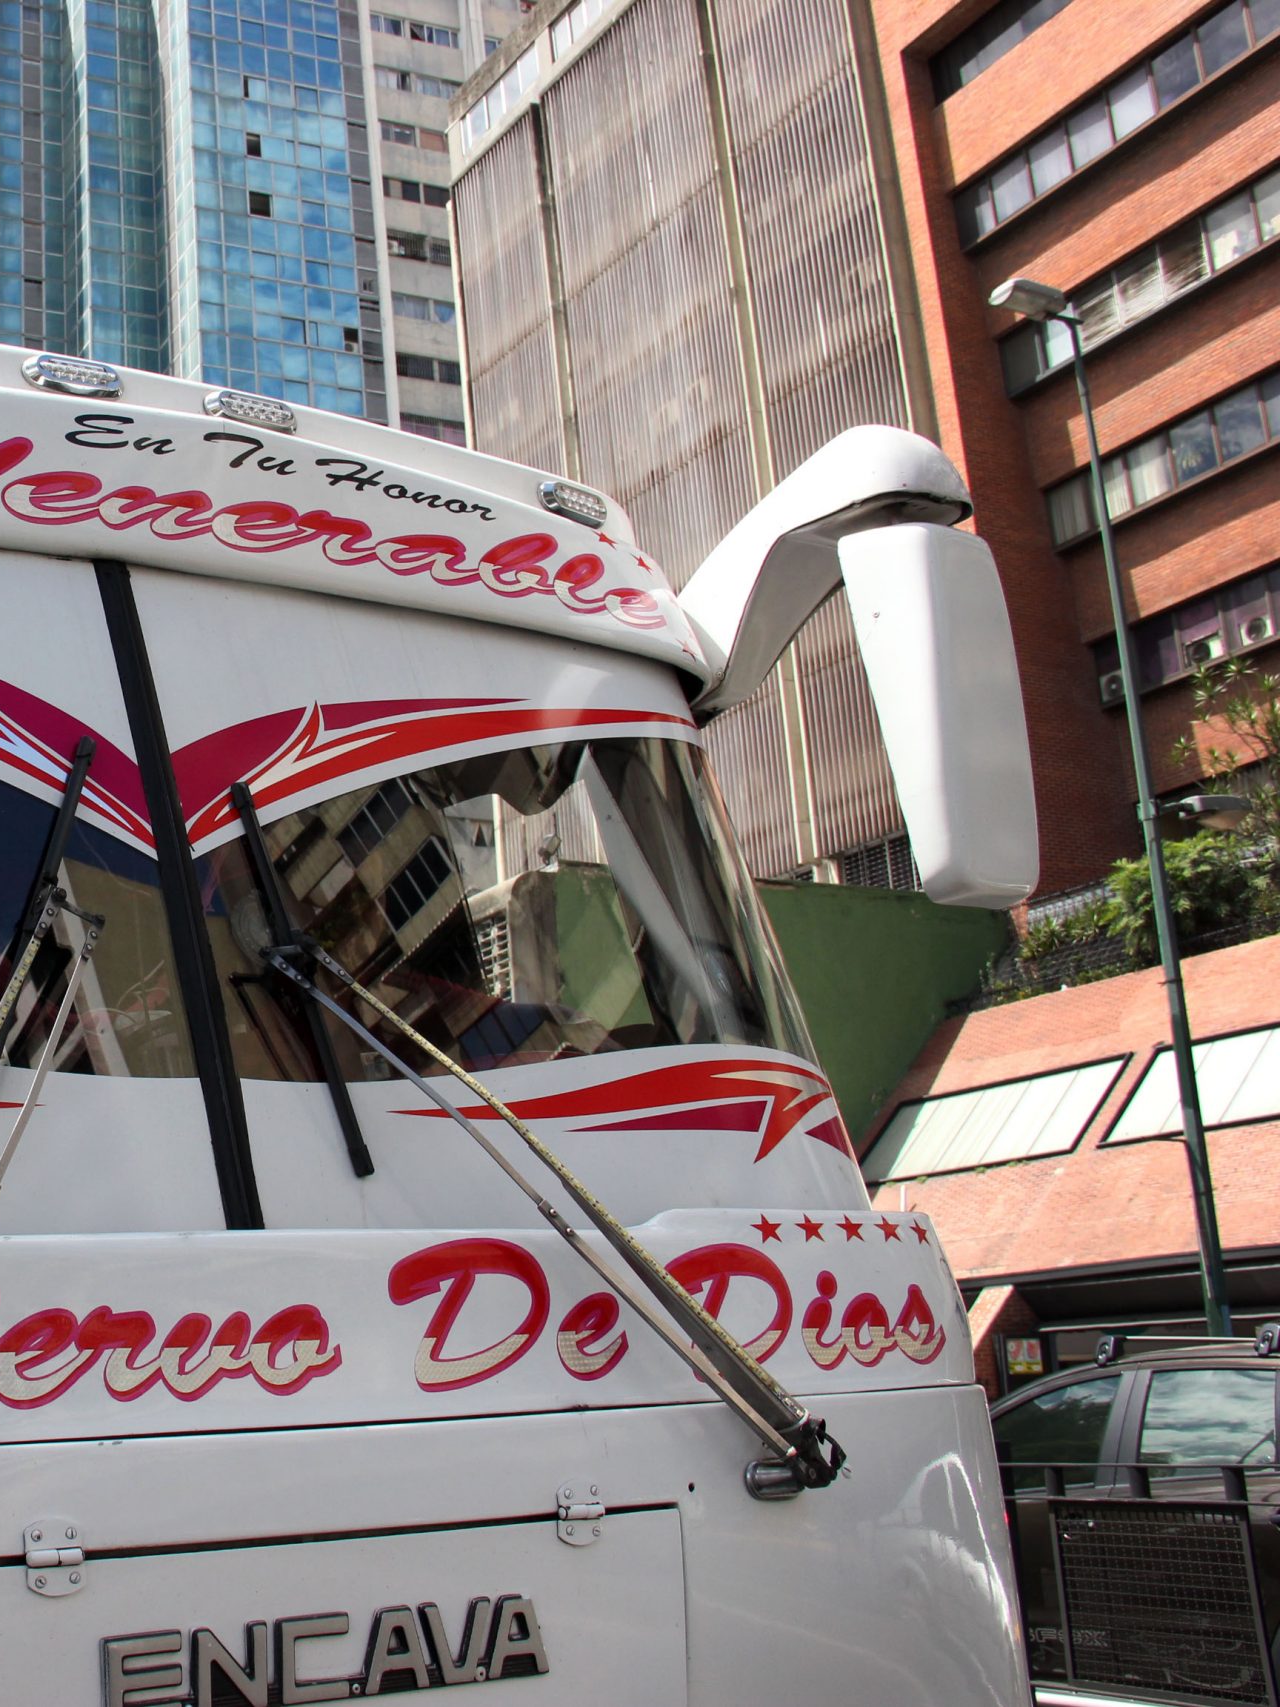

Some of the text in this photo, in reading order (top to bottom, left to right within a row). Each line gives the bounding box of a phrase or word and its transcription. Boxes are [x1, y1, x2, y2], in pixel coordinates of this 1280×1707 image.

[64, 413, 497, 522] En Tu Honor
[387, 1238, 630, 1394] De
[663, 1242, 947, 1384] Dios
[99, 1593, 550, 1707] ENCAVA
